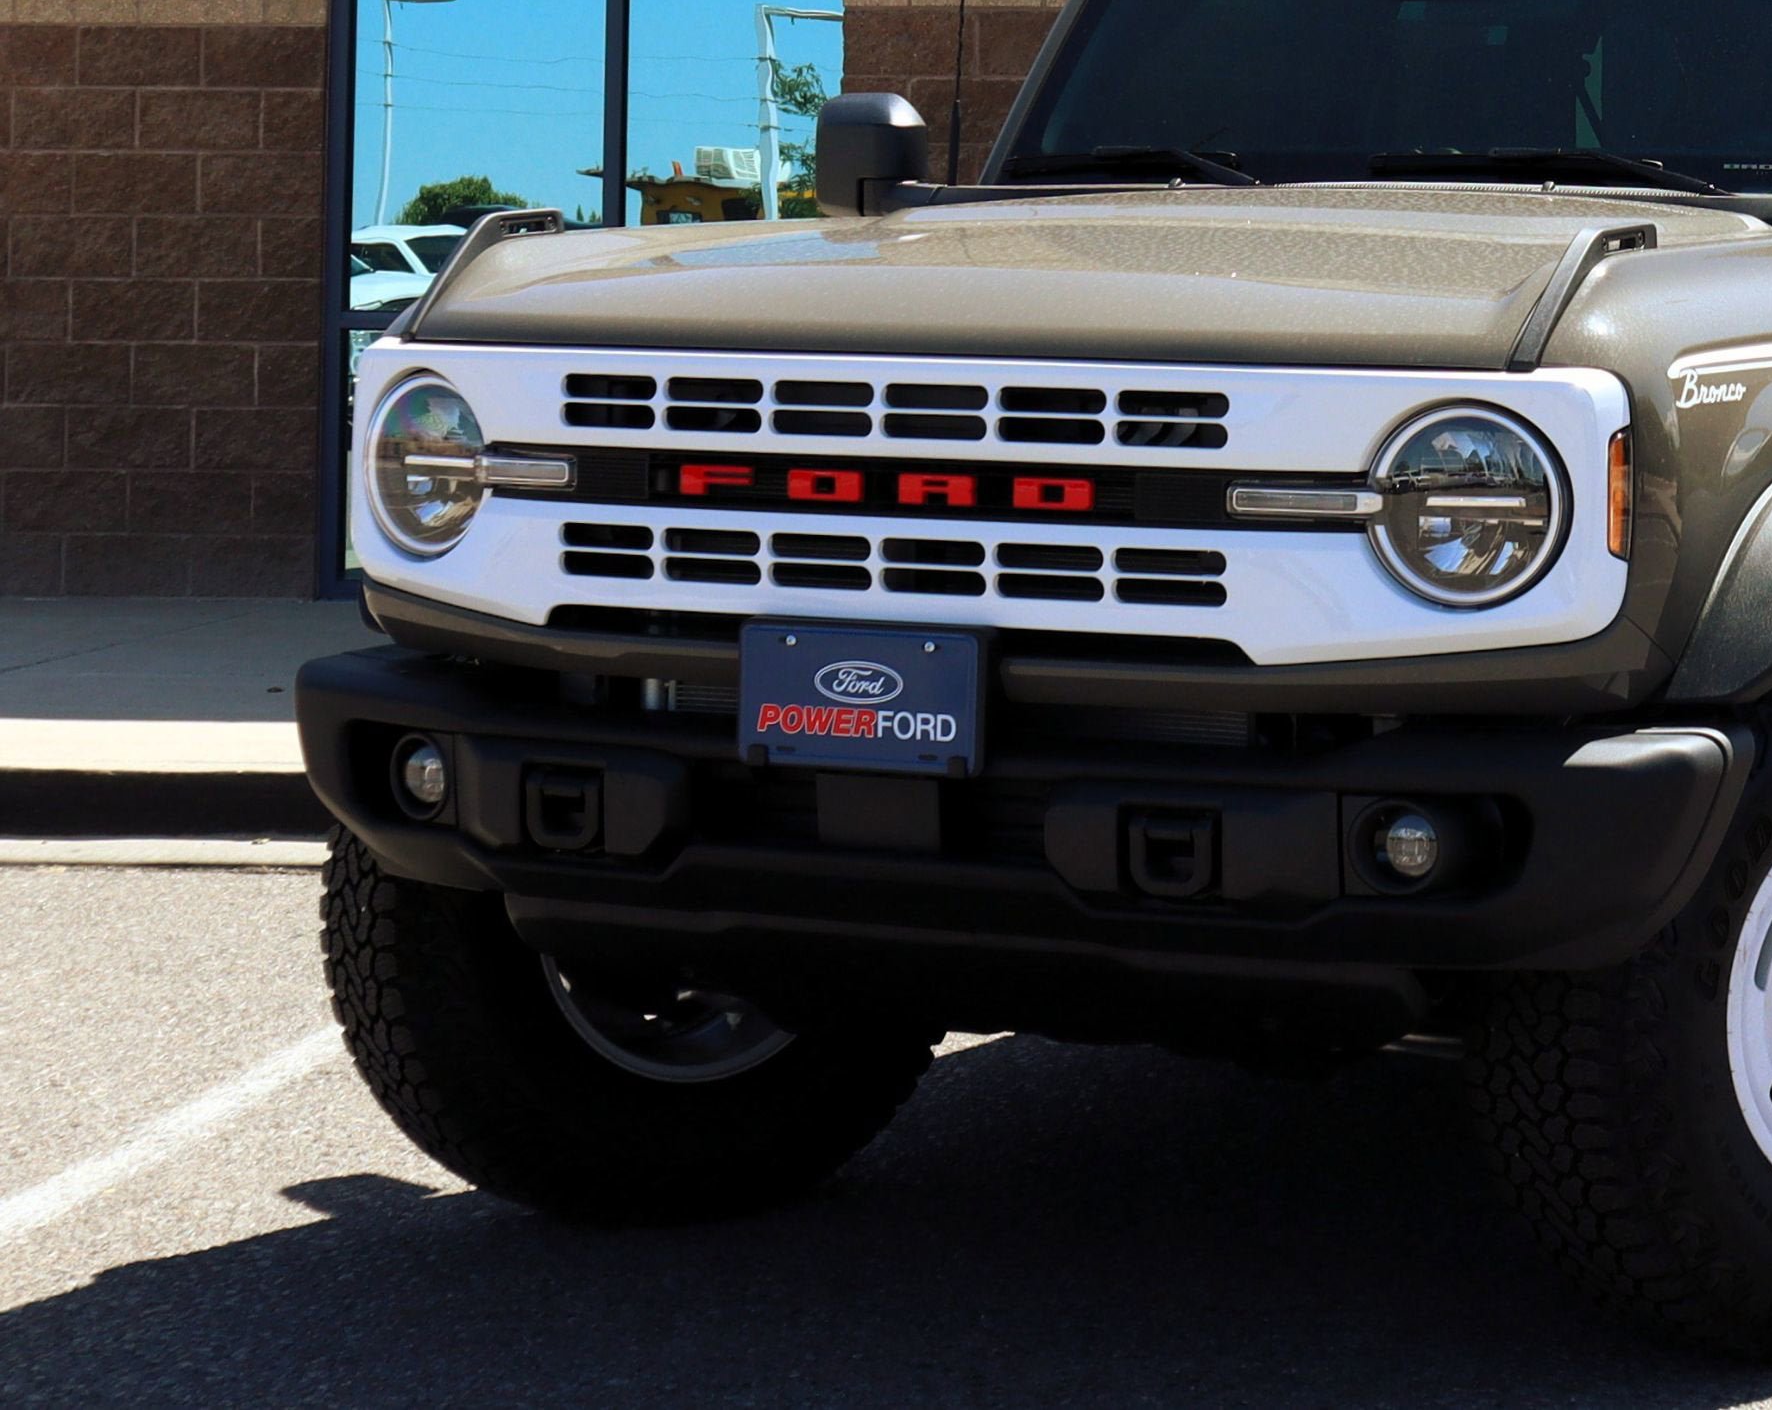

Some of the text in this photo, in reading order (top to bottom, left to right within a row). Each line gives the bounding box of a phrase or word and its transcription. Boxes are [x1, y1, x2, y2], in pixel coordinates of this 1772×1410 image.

[1676, 368, 1747, 409] Bronco
[679, 464, 1095, 511] FORD
[832, 668, 886, 696] Ford
[757, 703, 957, 742] POWERFORD
